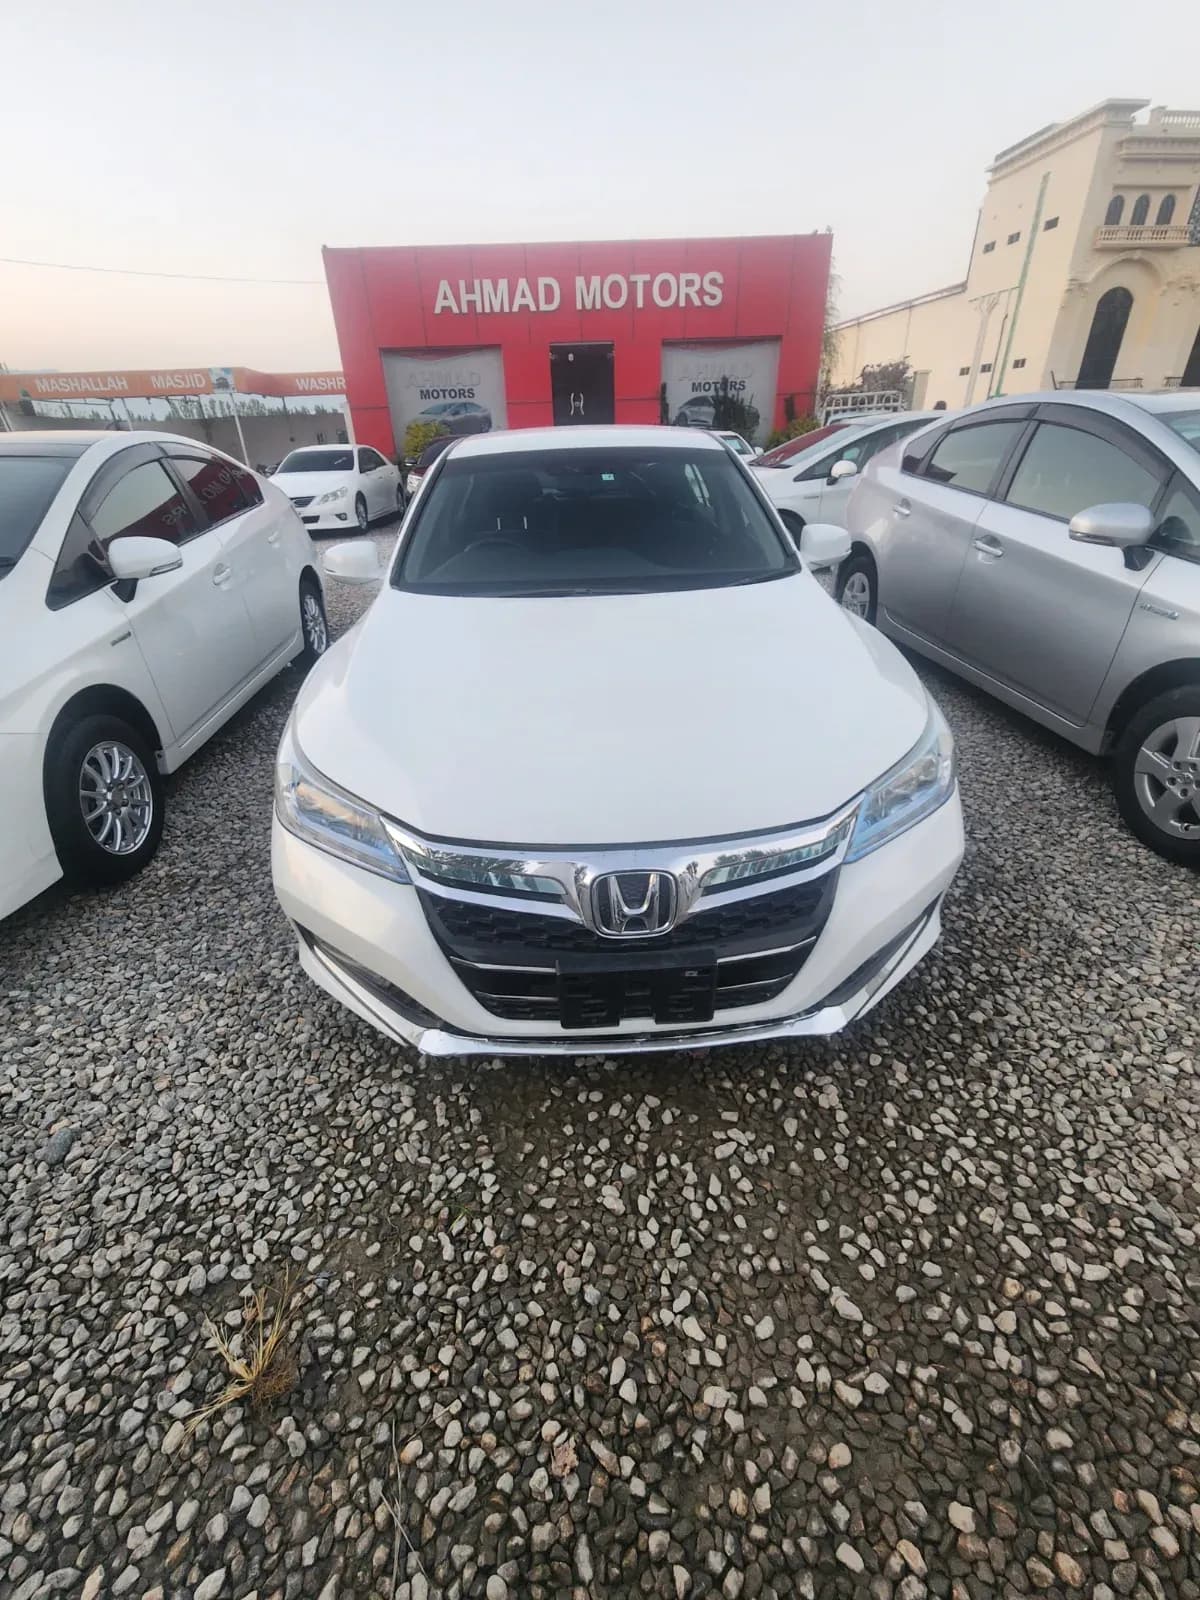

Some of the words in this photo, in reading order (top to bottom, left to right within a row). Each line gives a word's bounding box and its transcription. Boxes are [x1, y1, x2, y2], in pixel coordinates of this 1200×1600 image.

[434, 277, 561, 314] AHMAD
[575, 271, 724, 310] MOTORS
[35, 376, 129, 392] MASHALLAH
[151, 373, 206, 389] MASJID
[420, 388, 475, 400] MOTORS
